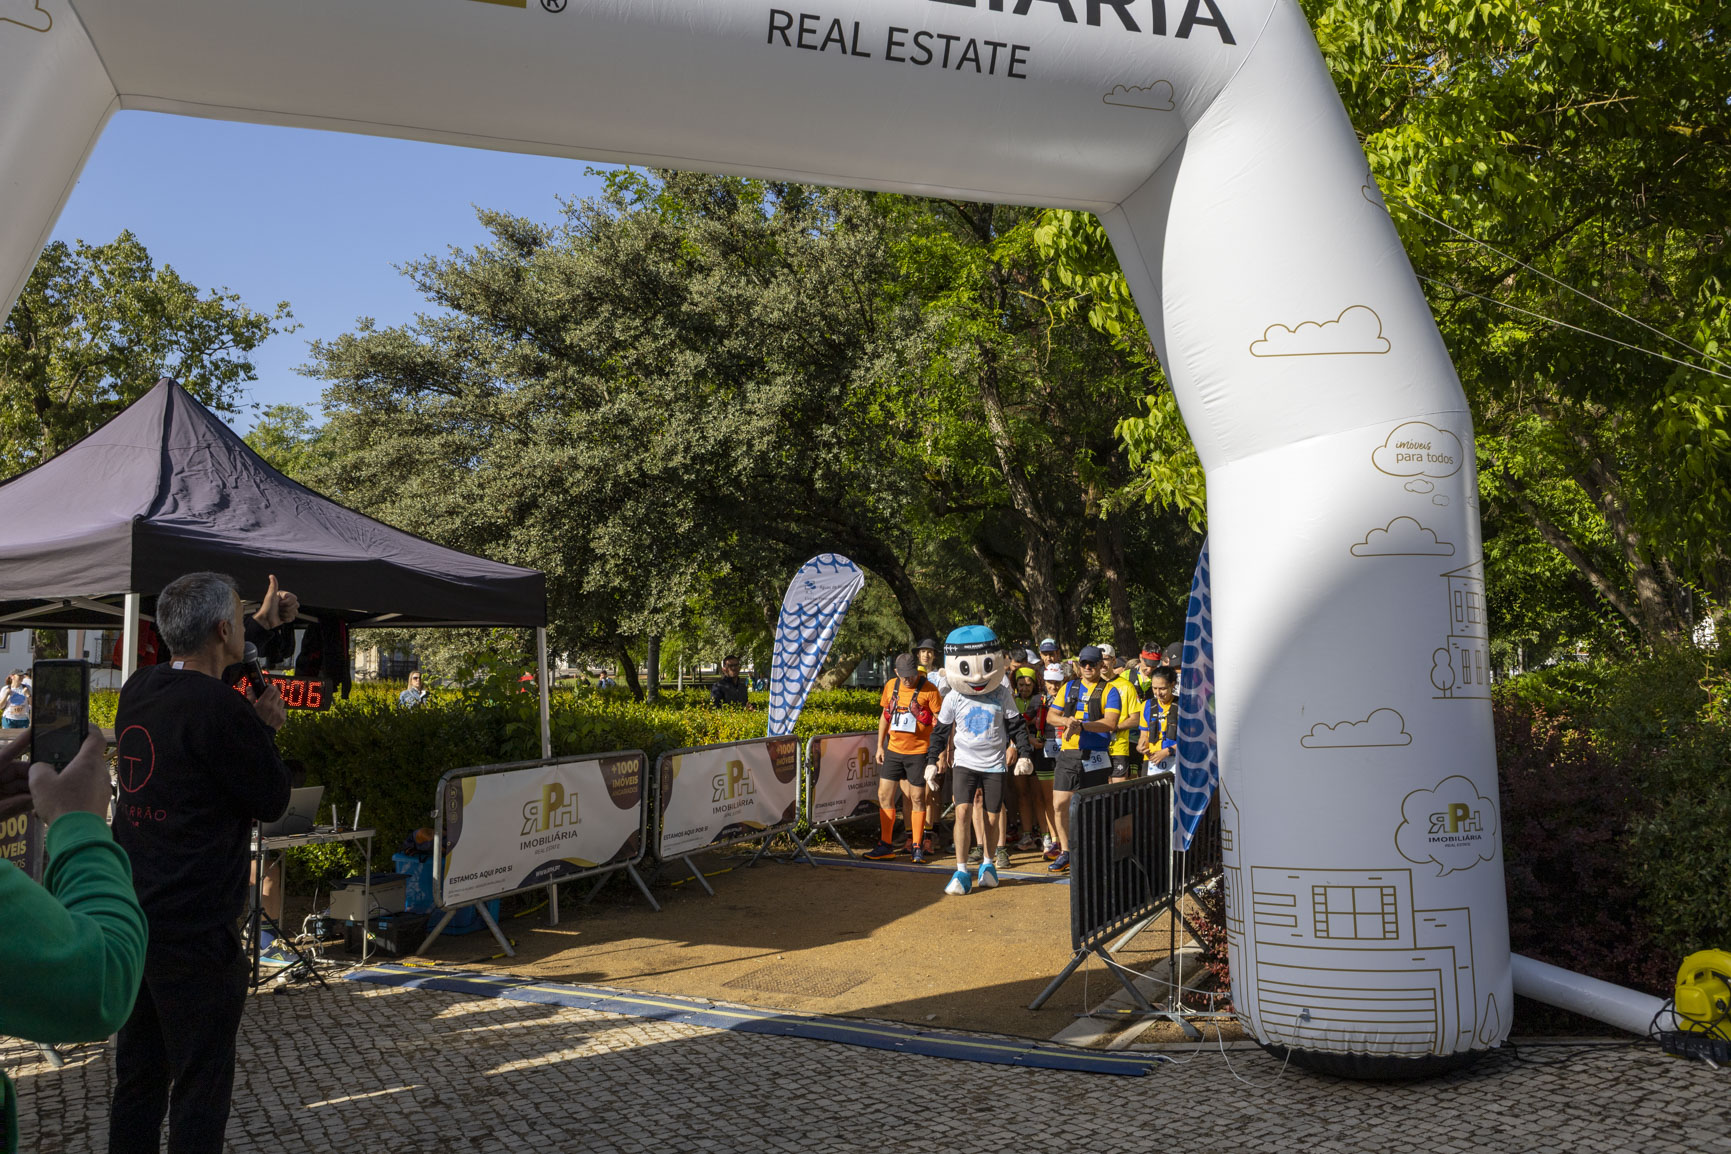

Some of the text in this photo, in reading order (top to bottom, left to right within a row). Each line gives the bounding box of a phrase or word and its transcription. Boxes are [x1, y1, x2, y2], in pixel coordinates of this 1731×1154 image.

[767, 8, 1031, 79] REAL ESTATE
[1395, 438, 1431, 450] imóveis
[1396, 452, 1454, 465] para todos
[1090, 754, 1102, 764] 36
[611, 759, 639, 775] +1000
[612, 775, 639, 788] IMÓVEIS
[520, 829, 578, 850] IMOBILIÁRIA
[1428, 834, 1482, 843] IMOBILIÁRIA
[0, 840, 26, 858] VEIS
[449, 872, 479, 885] ESTAMOS
[479, 869, 495, 879] AQUI
[494, 866, 507, 875] POR
